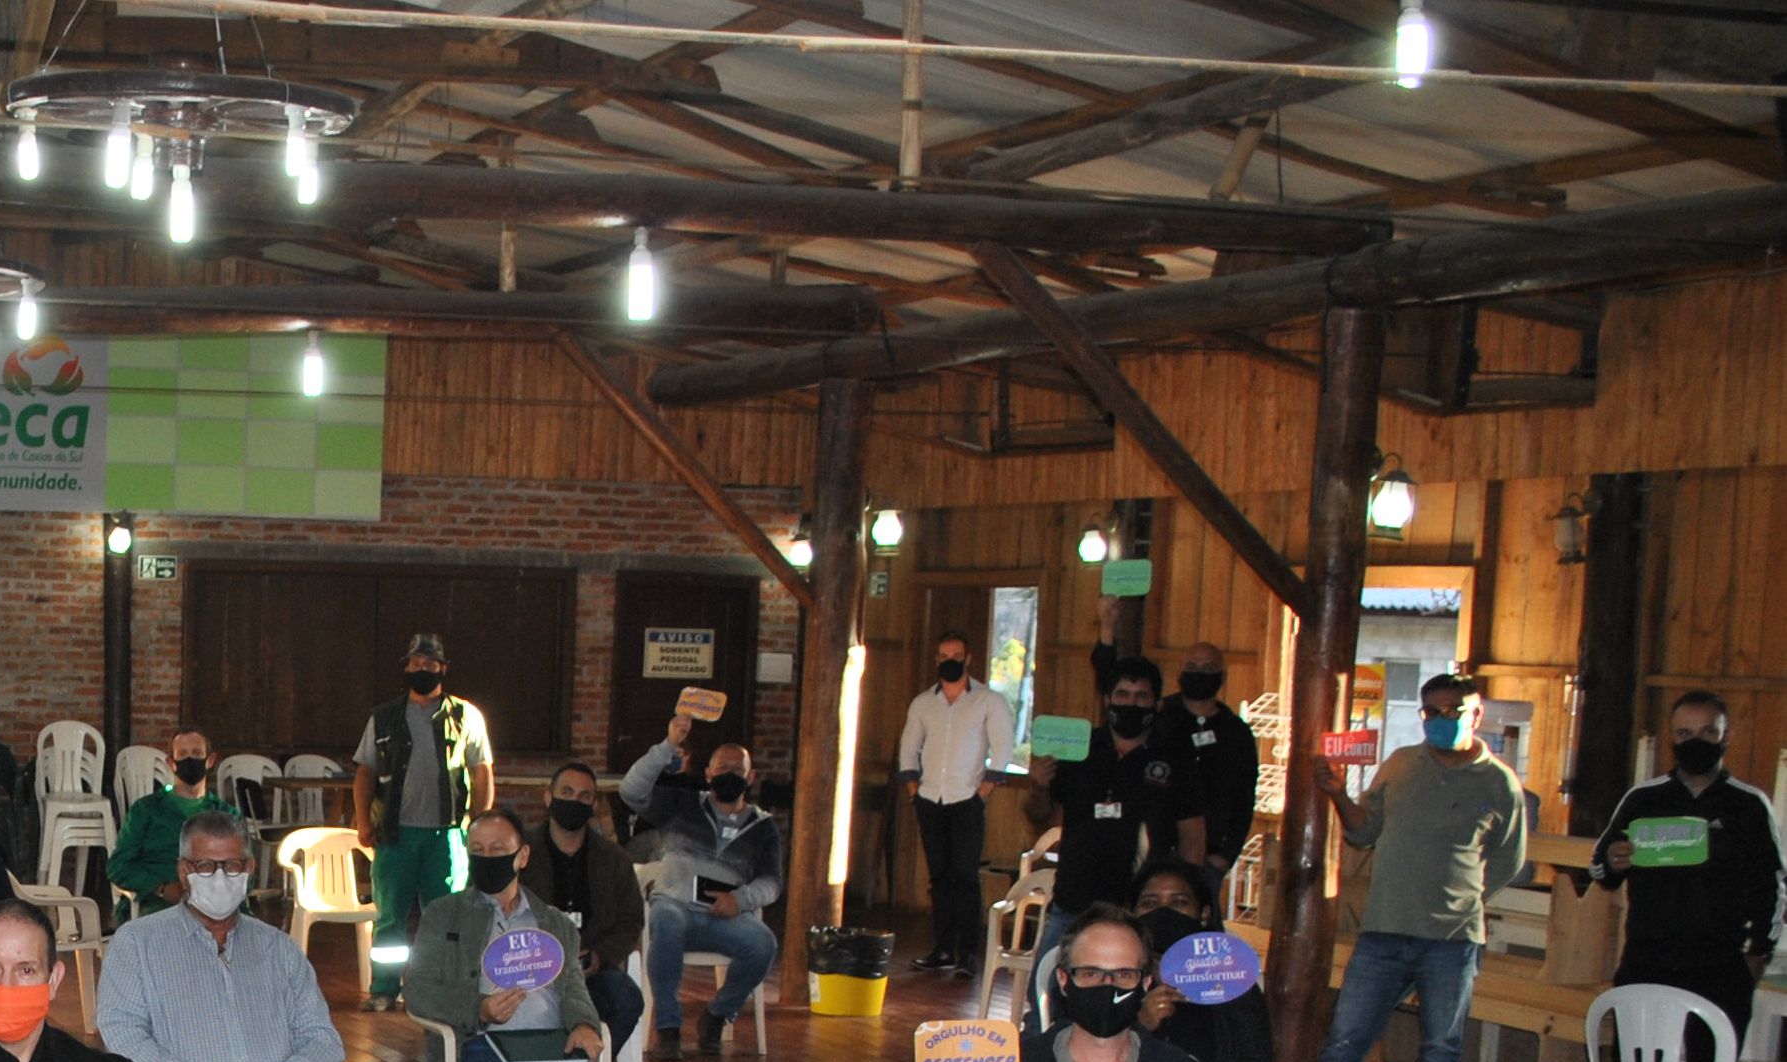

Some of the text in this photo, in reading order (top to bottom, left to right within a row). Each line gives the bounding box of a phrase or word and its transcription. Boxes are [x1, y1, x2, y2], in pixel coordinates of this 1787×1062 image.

[658, 632, 704, 642] AVISO
[659, 646, 700, 654] SOMENTE
[660, 656, 698, 664] PESSOAL
[651, 664, 707, 673] AUTORIZADO
[1325, 736, 1342, 756] EU
[509, 932, 532, 950] EU
[1193, 936, 1221, 955] EU
[533, 947, 543, 957] a
[494, 960, 553, 976] transformar
[1185, 955, 1234, 973] ajudo a
[1174, 969, 1247, 984] transformar
[925, 1024, 1007, 1049] ORGULHO EM
